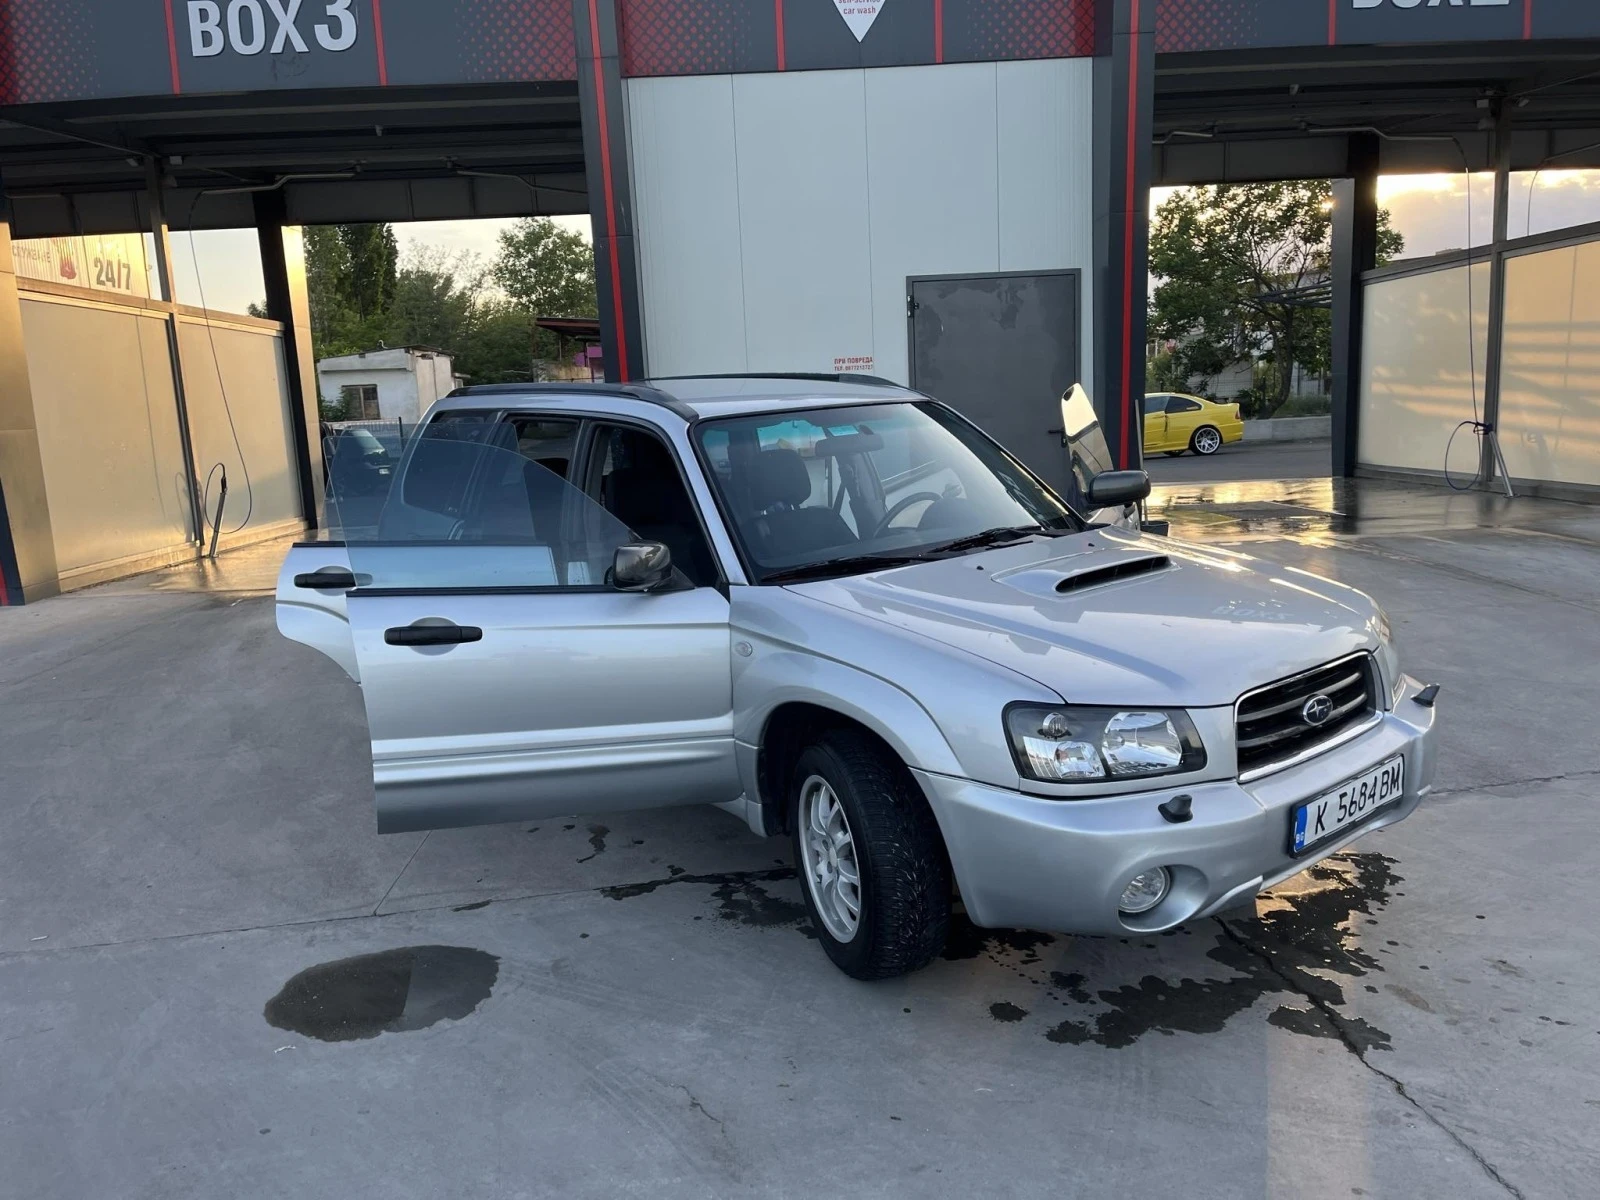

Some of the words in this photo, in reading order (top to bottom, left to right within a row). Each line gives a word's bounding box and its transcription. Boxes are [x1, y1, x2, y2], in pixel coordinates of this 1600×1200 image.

[857, 6, 876, 14] wash
[187, 0, 310, 57] BOX
[93, 256, 132, 291] 24/7
[847, 356, 873, 364] ПОВРЕДА
[1315, 801, 1328, 835] K
